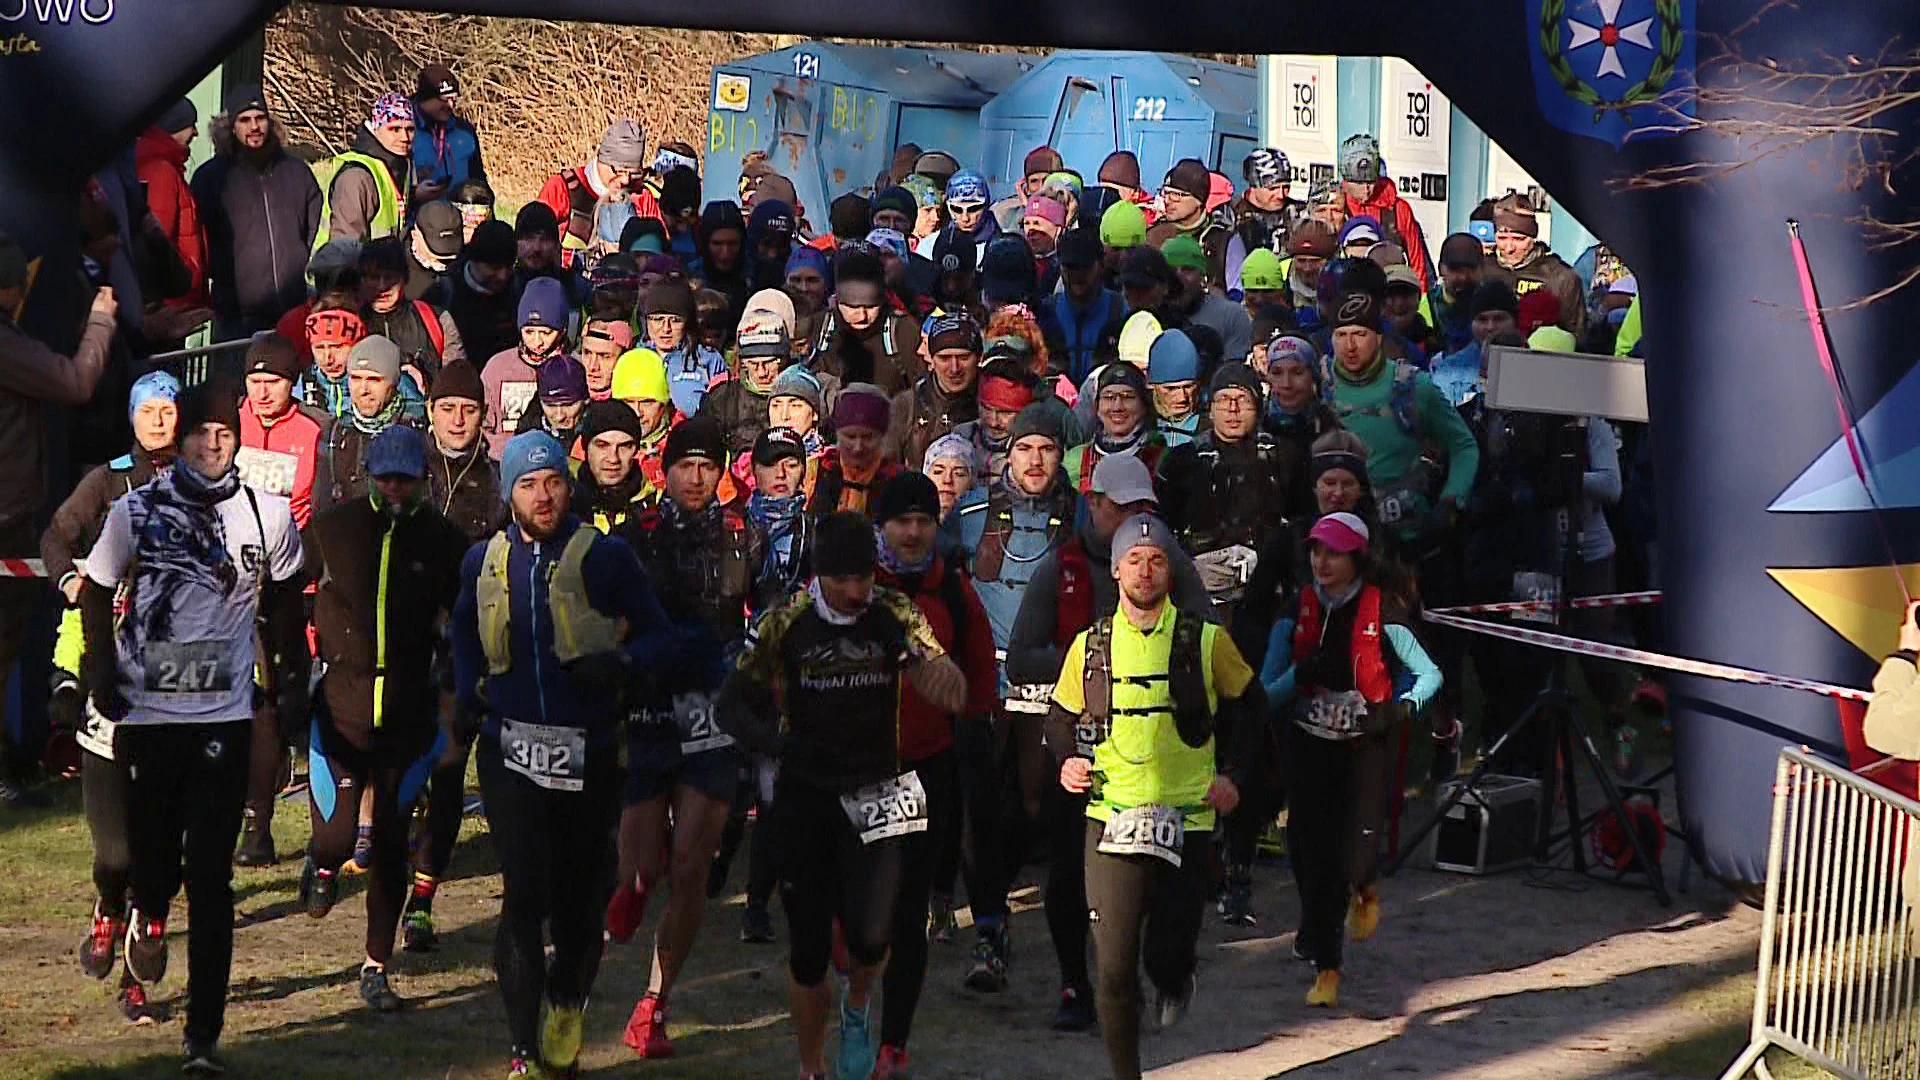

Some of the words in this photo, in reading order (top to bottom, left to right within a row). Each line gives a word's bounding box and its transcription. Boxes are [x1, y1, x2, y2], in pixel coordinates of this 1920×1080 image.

[793, 53, 820, 80] 121
[1293, 82, 1316, 105] TOI
[1407, 92, 1431, 115] TOI
[832, 86, 879, 142] BIO
[1133, 97, 1167, 120] 212
[1293, 105, 1316, 128] TOI
[711, 112, 758, 158] BIO
[1406, 114, 1431, 138] TOI
[158, 659, 218, 690] 247
[511, 740, 571, 776] 302
[1113, 818, 1177, 848] 280
